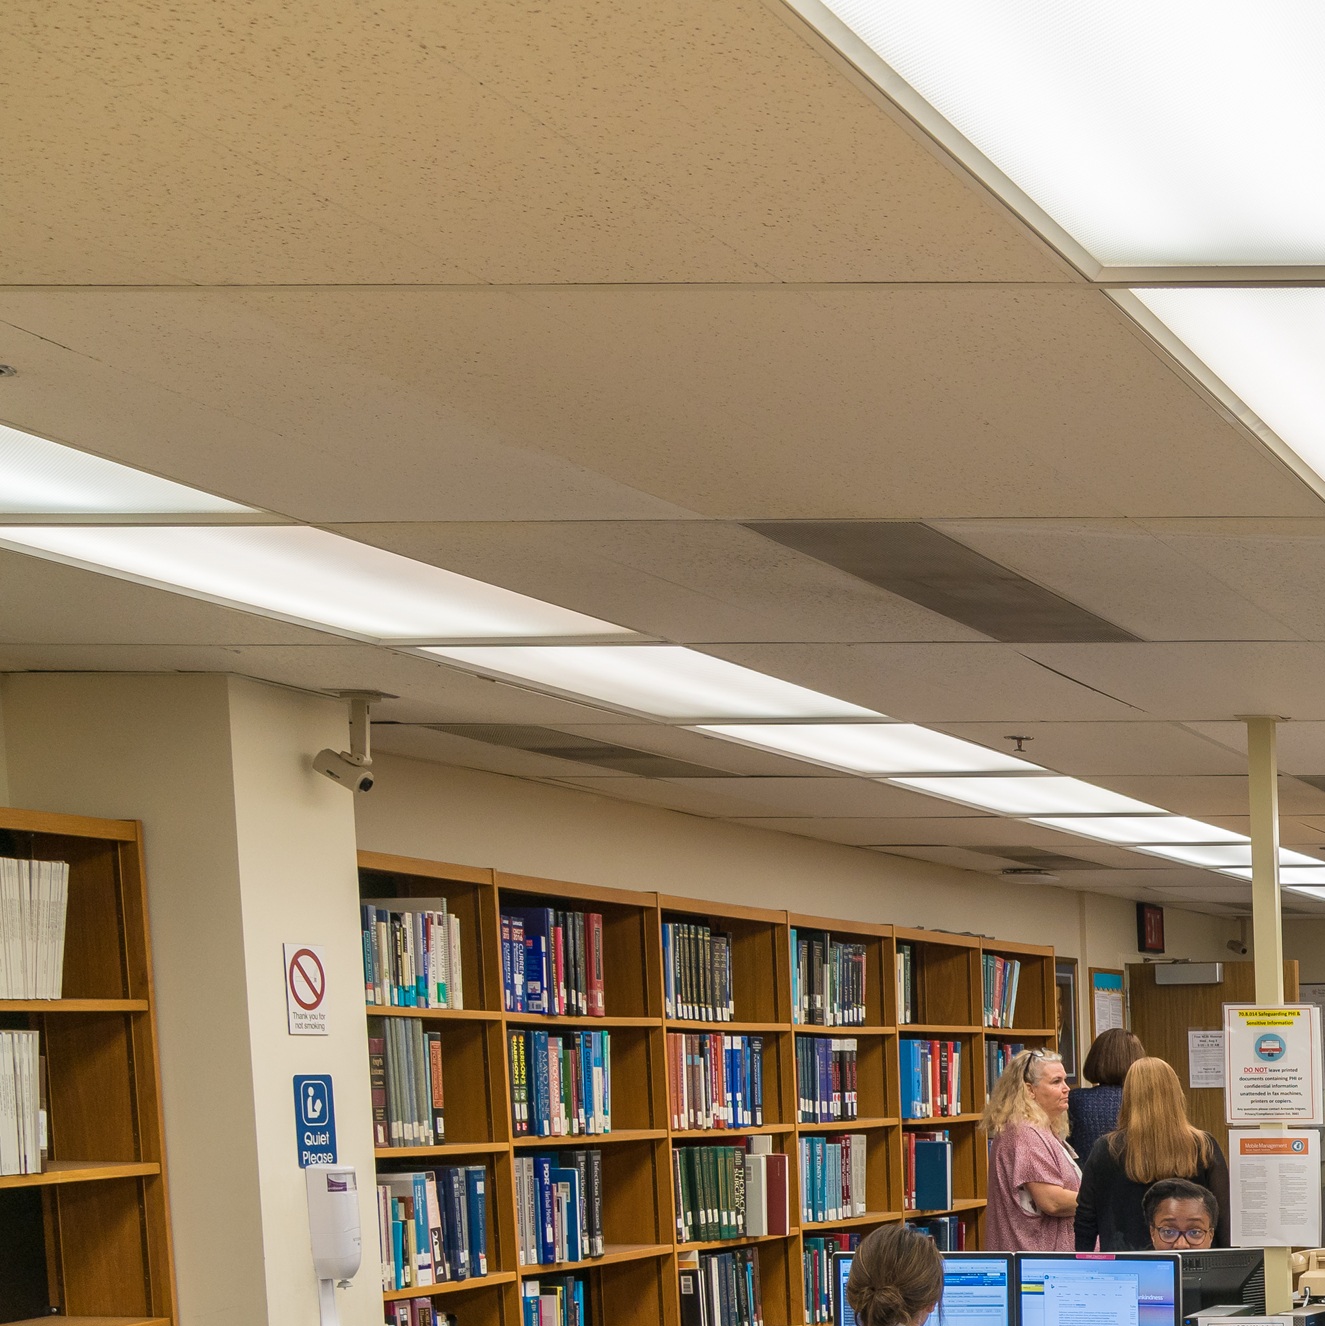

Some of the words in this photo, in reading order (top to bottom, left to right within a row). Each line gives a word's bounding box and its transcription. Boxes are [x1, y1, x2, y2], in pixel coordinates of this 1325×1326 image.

[293, 1011, 308, 1020] Thank
[309, 1013, 318, 1022] you
[304, 1022, 325, 1031] smoking
[304, 1131, 330, 1146] Quiet
[303, 1151, 333, 1164] Please
